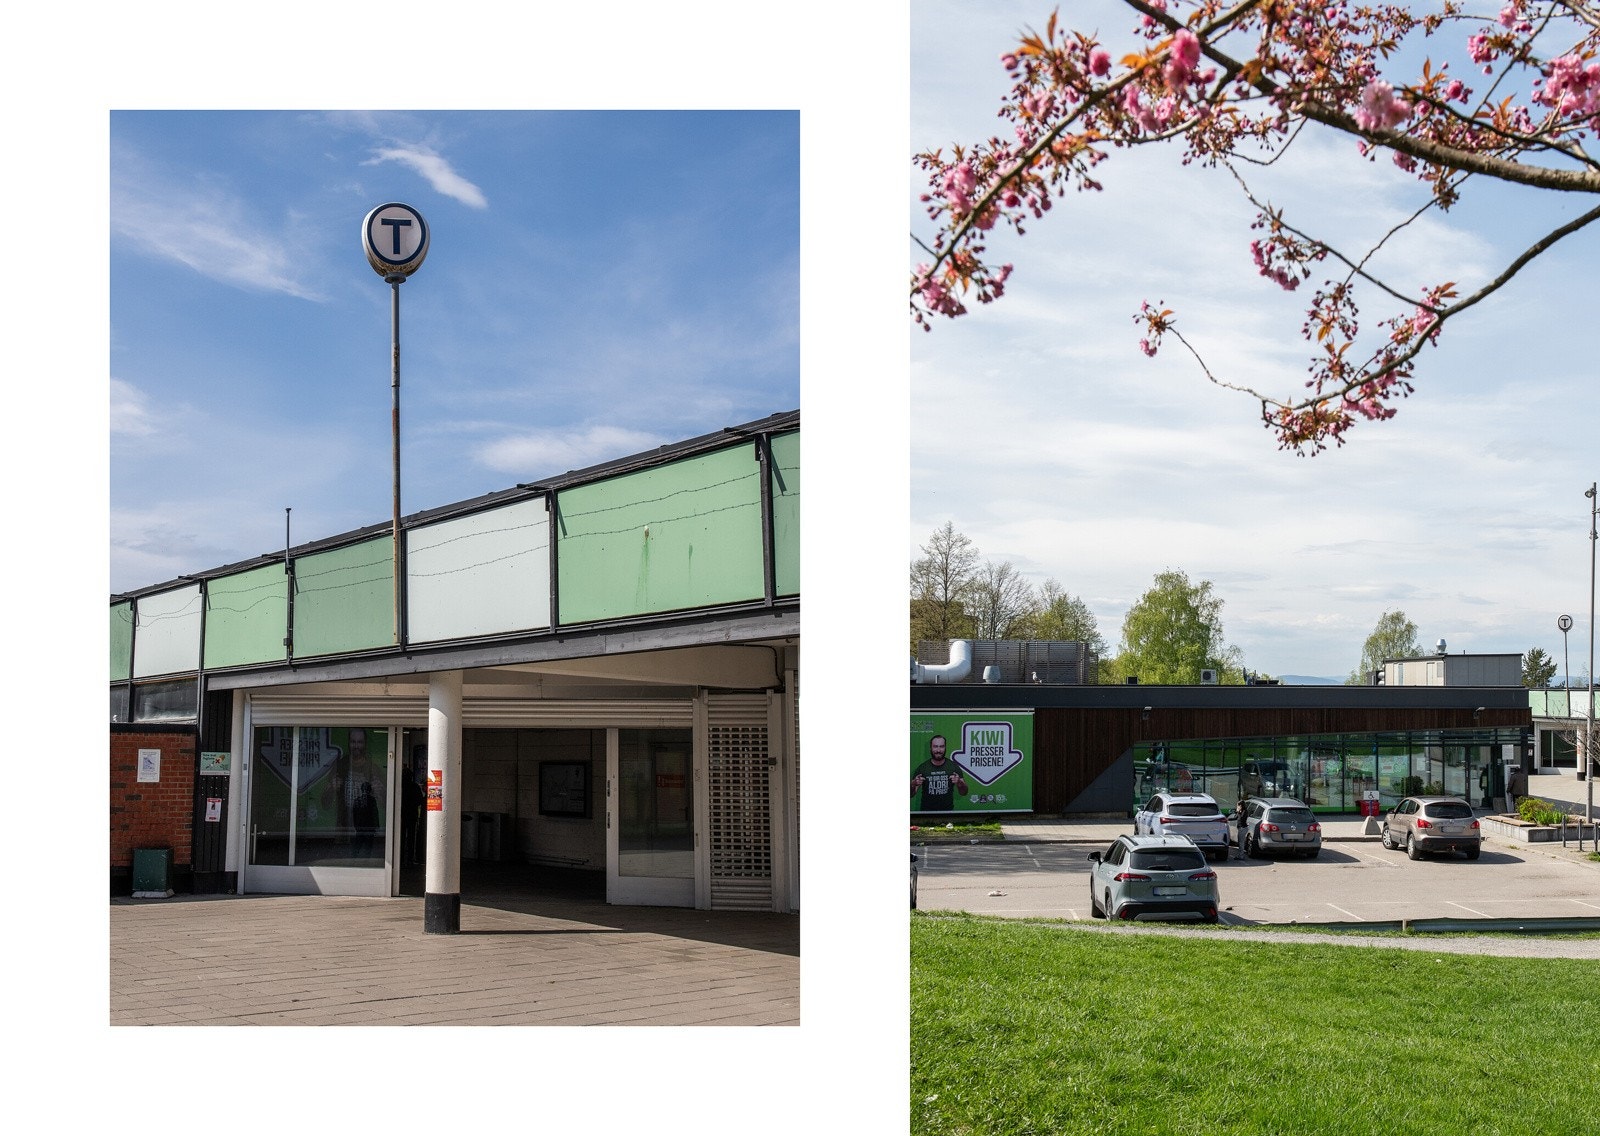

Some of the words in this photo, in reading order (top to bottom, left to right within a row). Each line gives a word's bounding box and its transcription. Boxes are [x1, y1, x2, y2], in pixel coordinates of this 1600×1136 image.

[381, 218, 411, 254] T
[1561, 618, 1569, 627] T
[971, 730, 1004, 745] KIWI
[970, 746, 1004, 756] PRESSER
[970, 757, 1004, 767] PRISENE!
